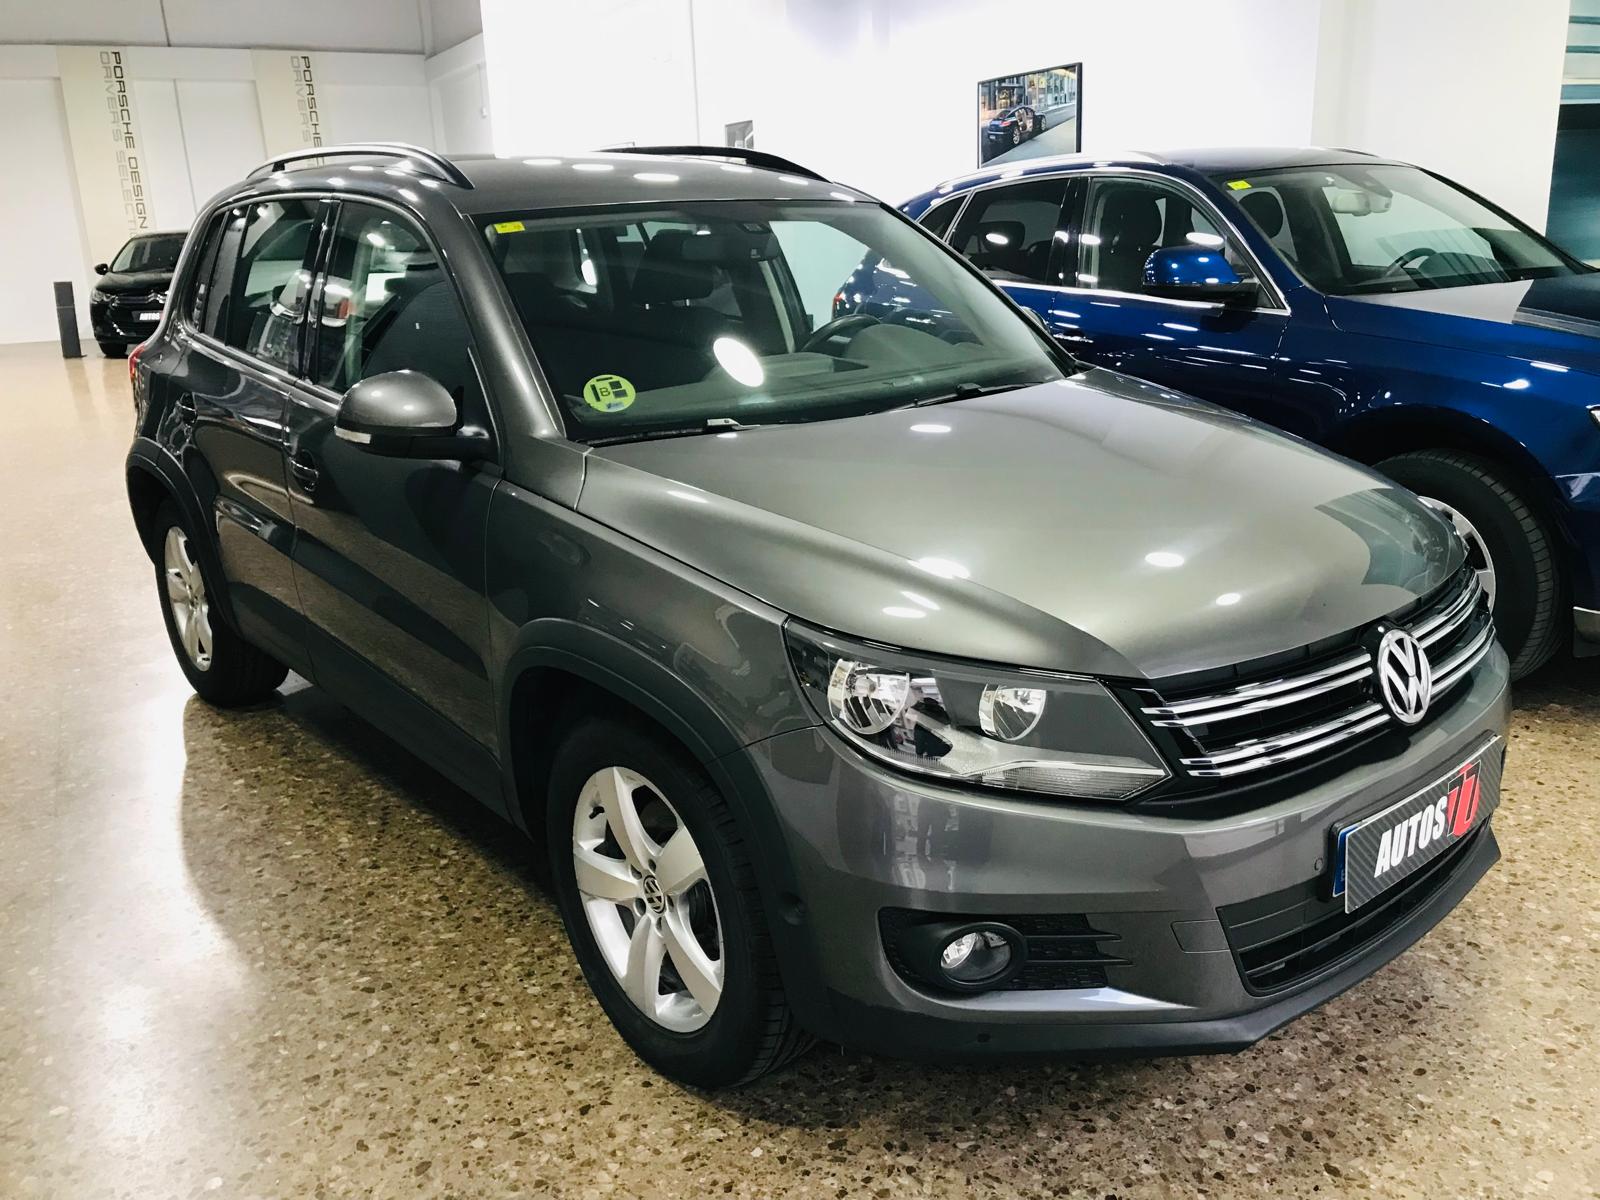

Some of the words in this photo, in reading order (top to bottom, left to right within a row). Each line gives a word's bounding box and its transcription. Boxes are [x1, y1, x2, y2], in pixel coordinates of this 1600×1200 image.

[100, 51, 122, 142] DRIVERS
[111, 51, 136, 149] PORSCHE
[128, 156, 148, 229] DESIGN
[290, 55, 312, 142] DRIVERS
[301, 56, 322, 148] PORSCHE
[1374, 795, 1448, 878] AUTOS
